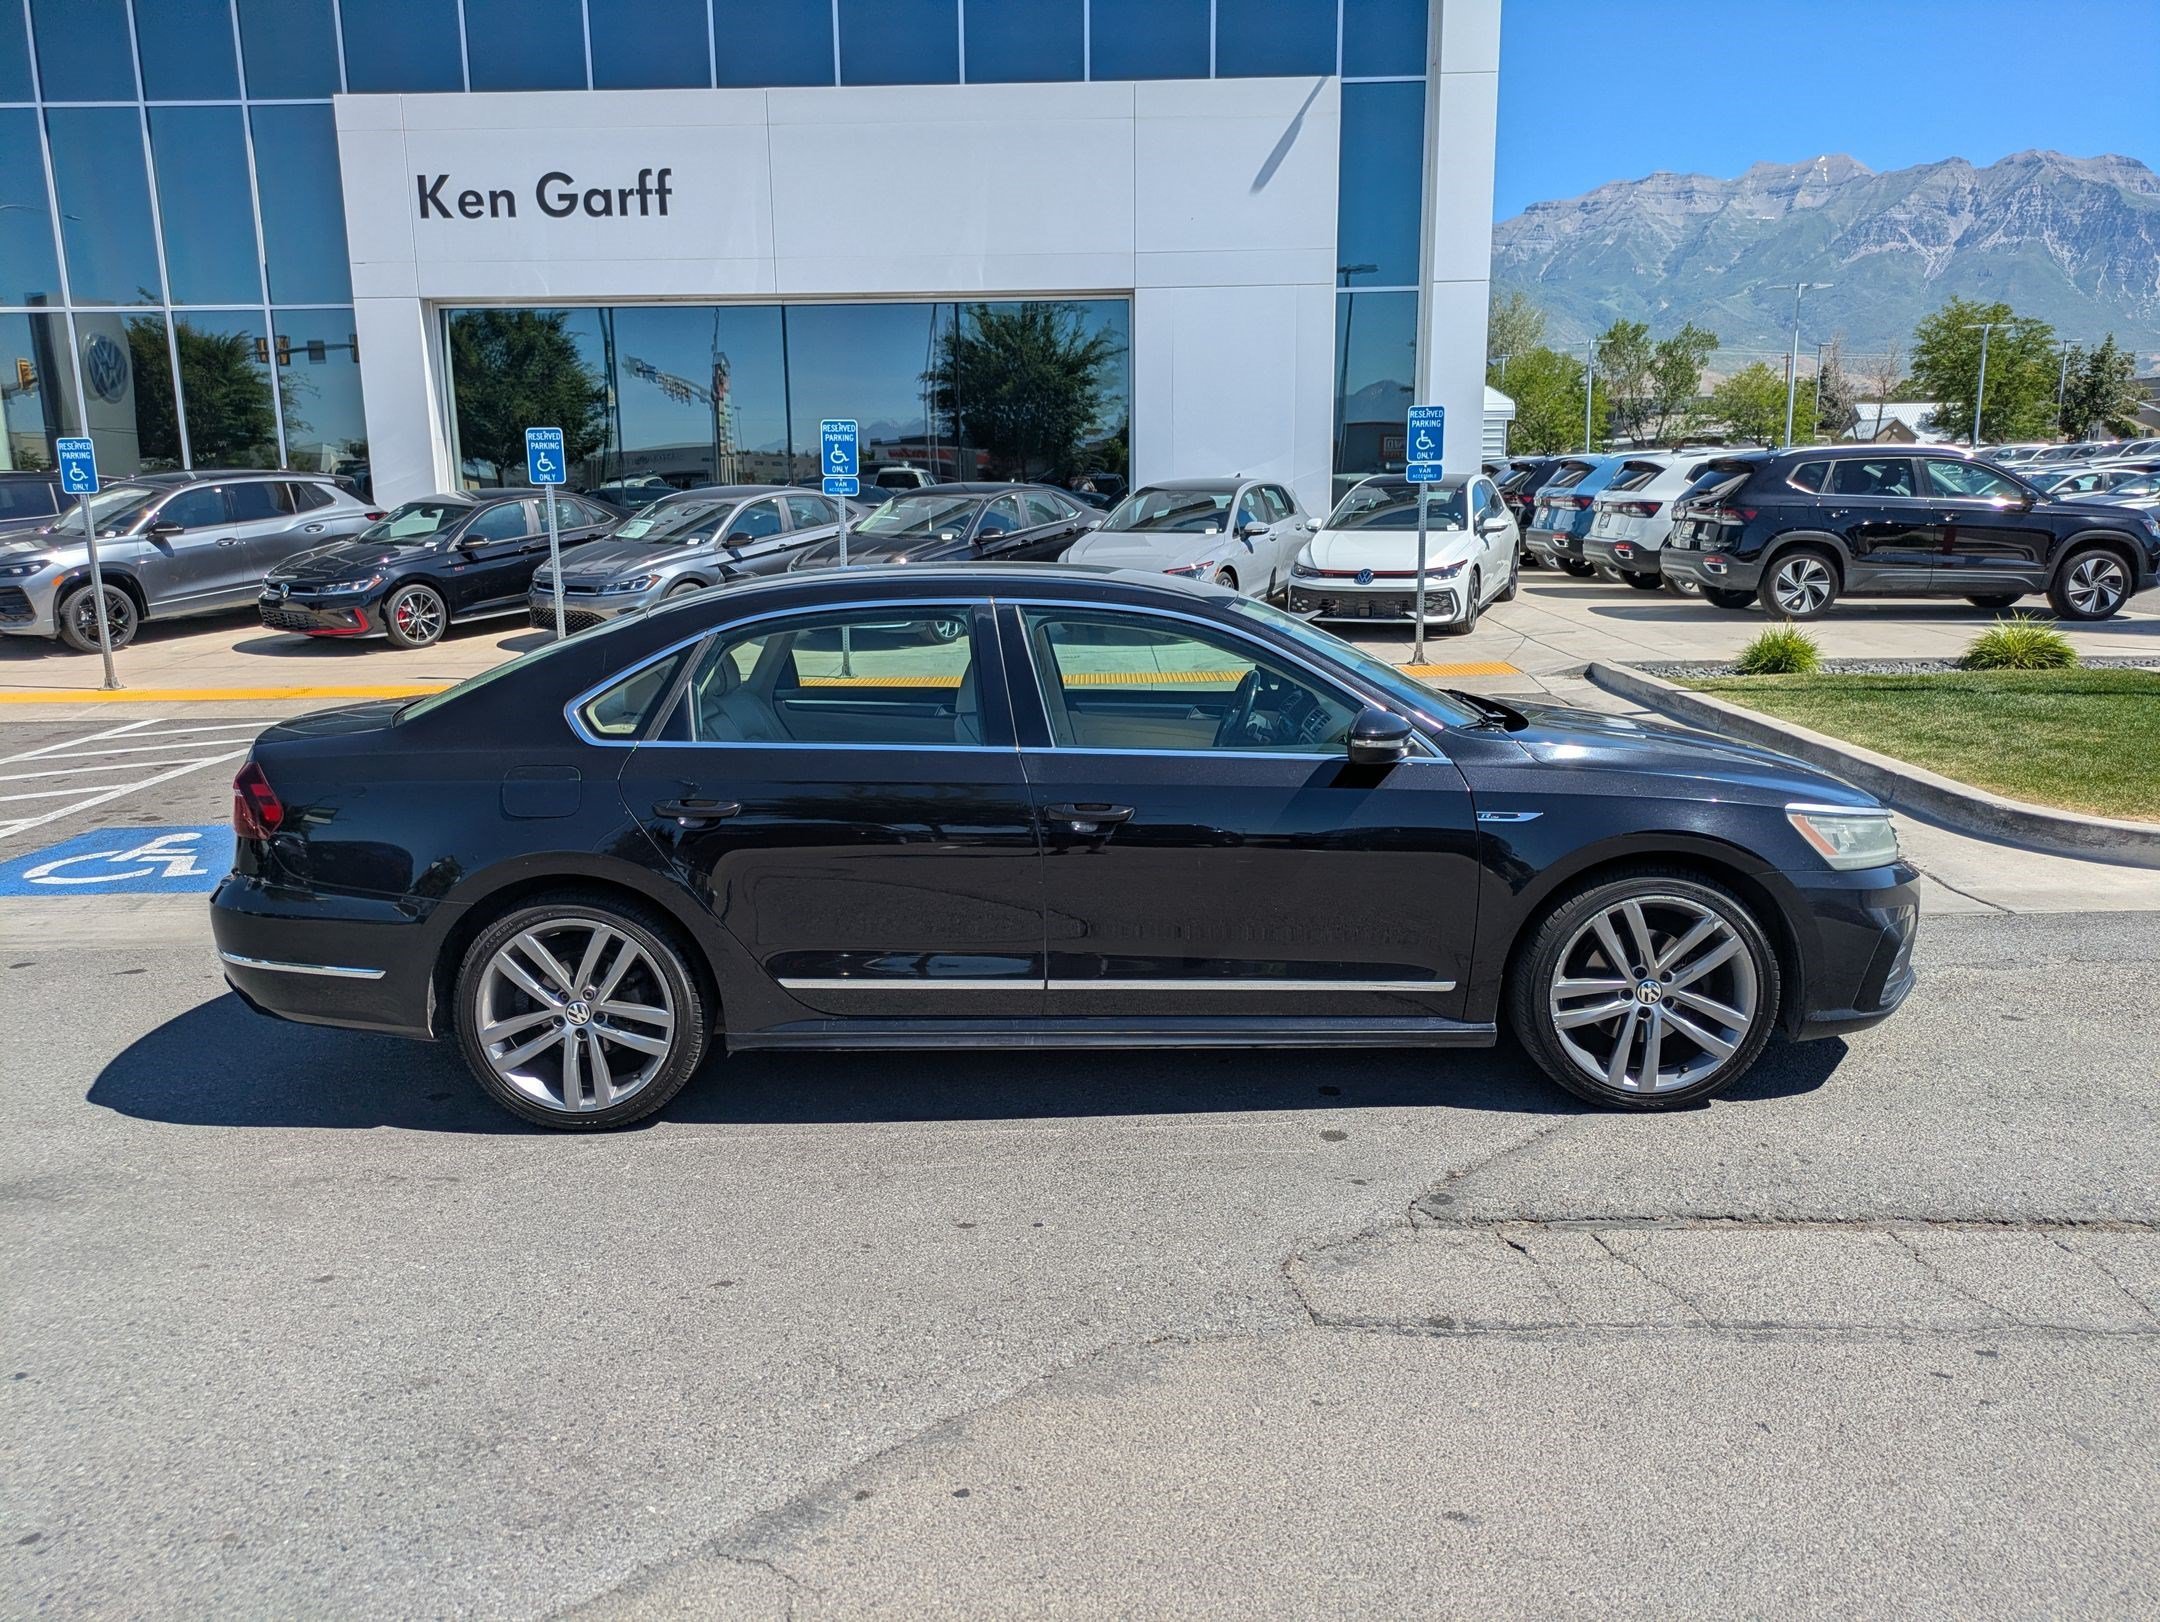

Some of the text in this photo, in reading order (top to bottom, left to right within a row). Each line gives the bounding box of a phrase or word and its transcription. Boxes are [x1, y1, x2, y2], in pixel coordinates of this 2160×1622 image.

[416, 168, 672, 219] Ken Garff
[1410, 410, 1443, 418] RESERVED
[822, 424, 856, 432] RESERVED
[1411, 420, 1441, 428] PARKING
[528, 432, 561, 440] RESERVED
[825, 433, 854, 442] PARKING
[59, 442, 91, 450] RESERVED
[530, 442, 560, 450] PARKING
[61, 452, 91, 460] PARKING
[1416, 452, 1434, 460] ONLY
